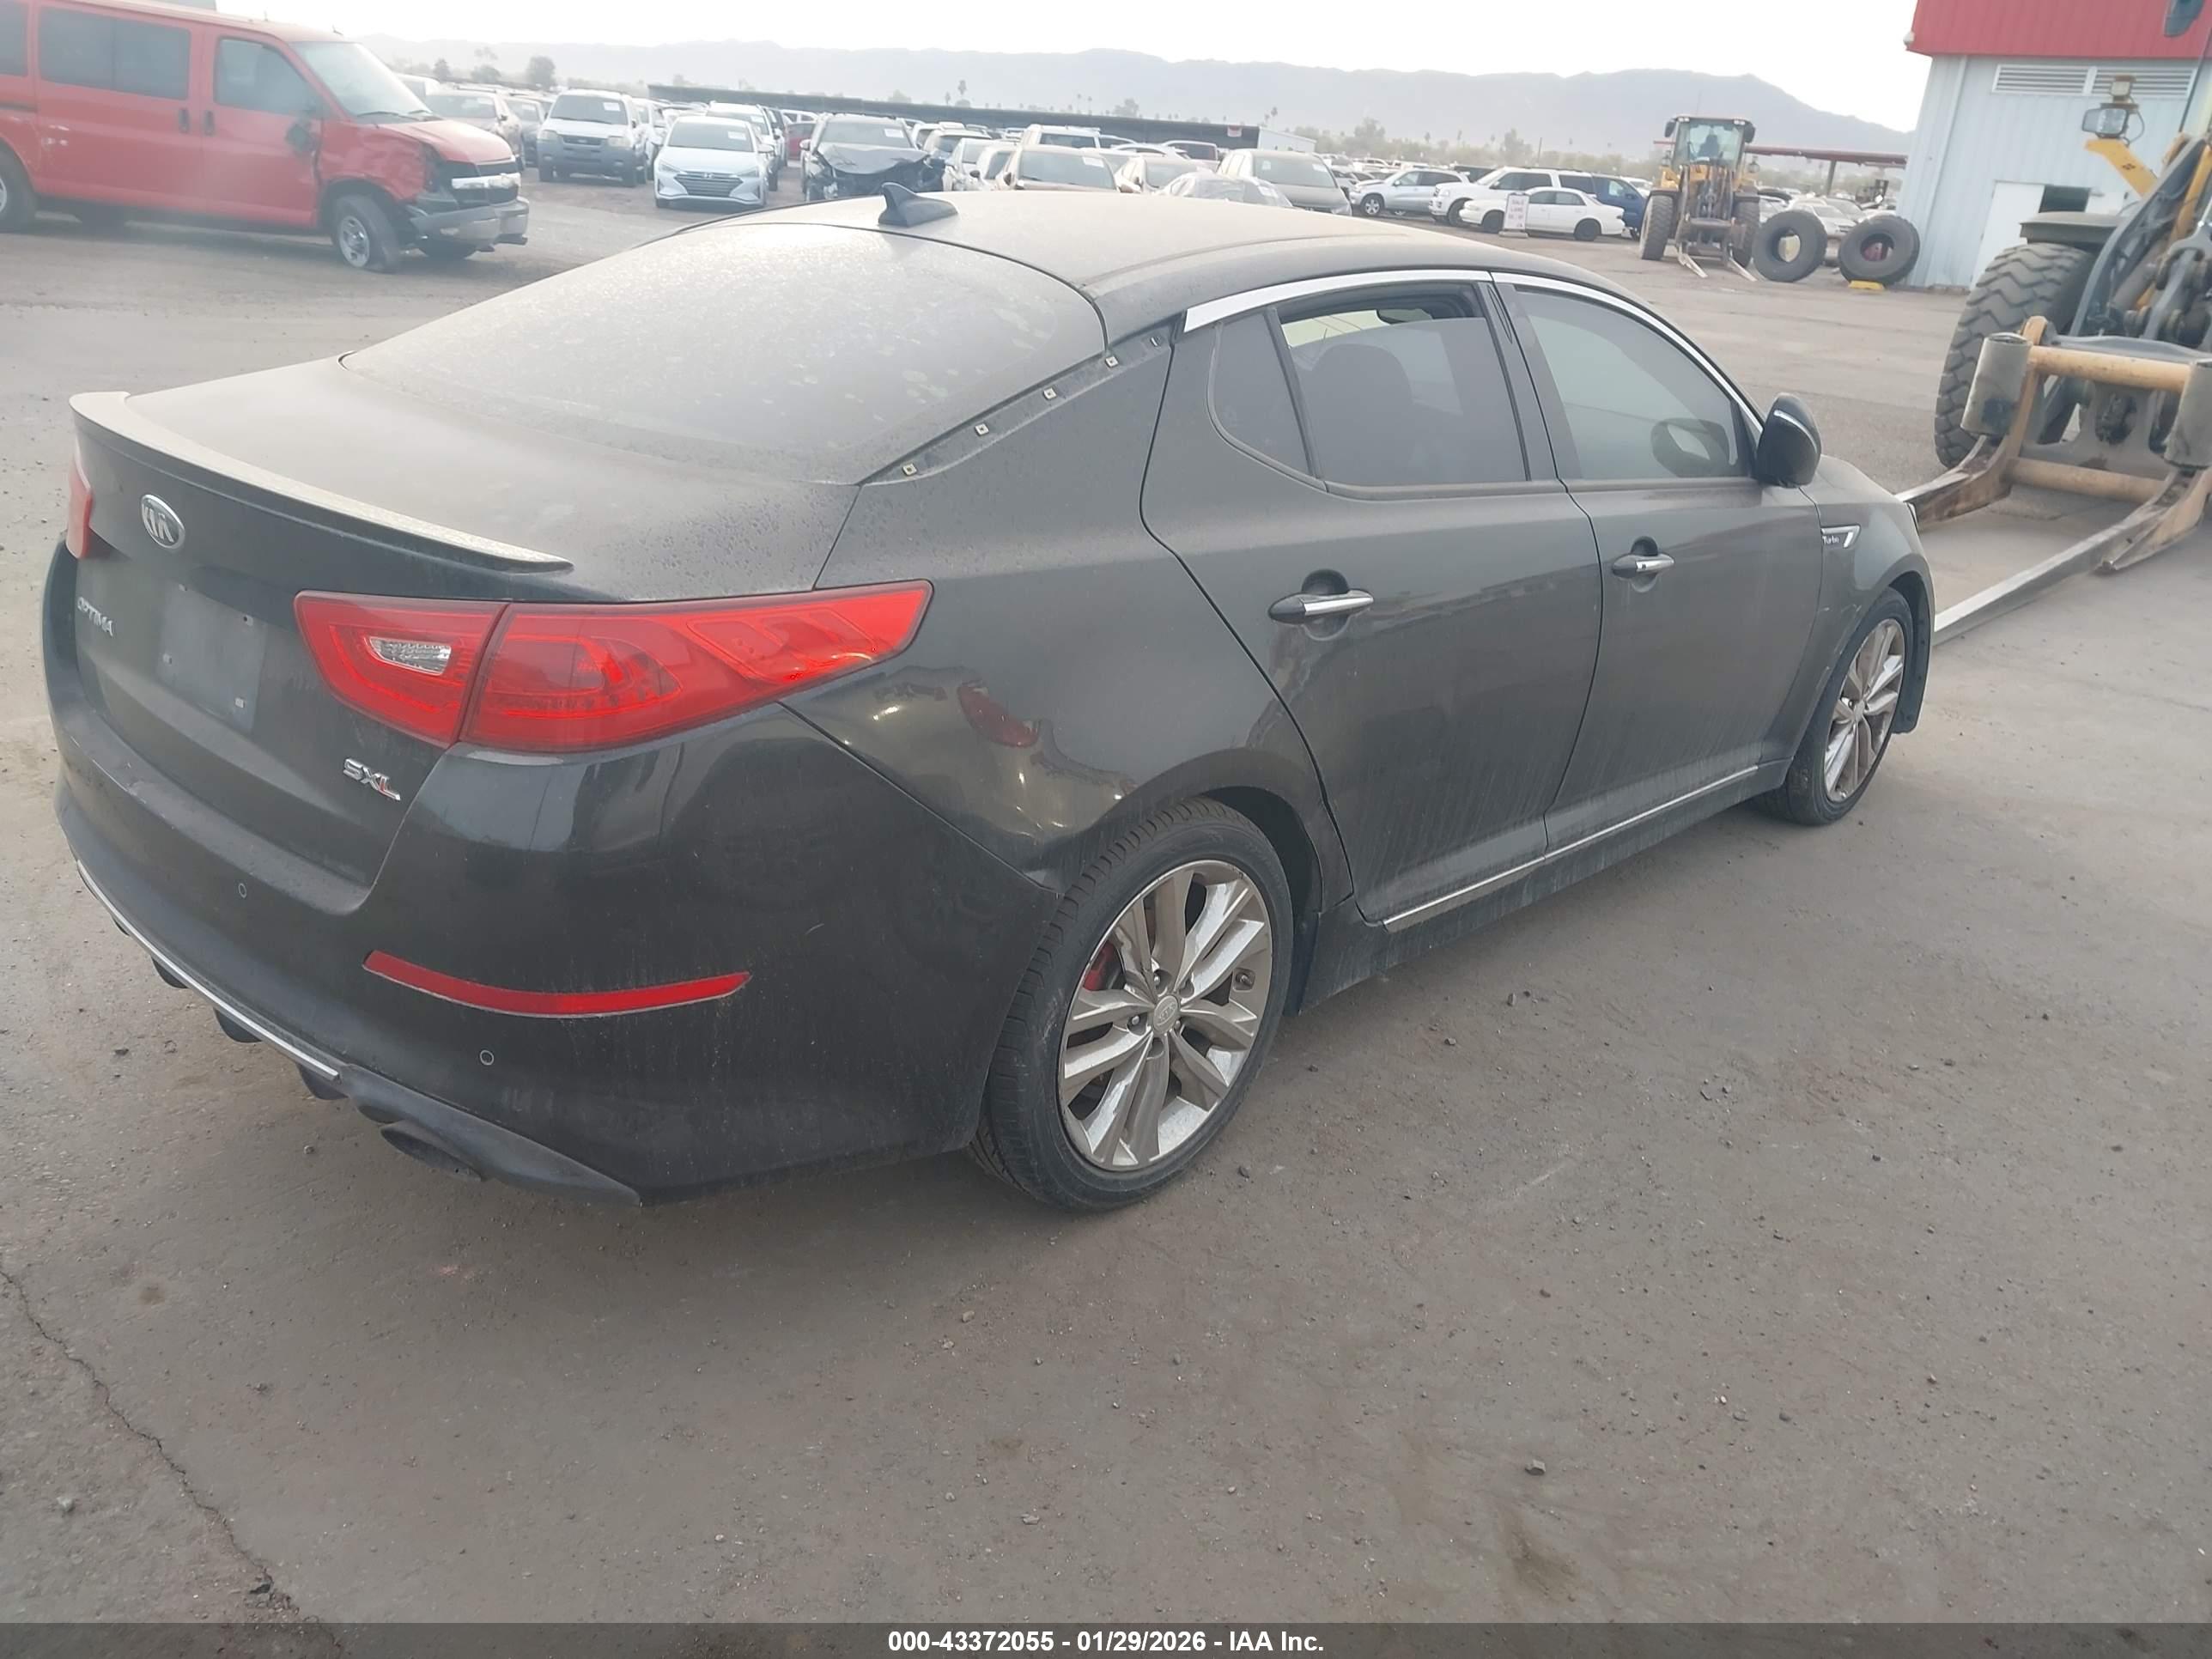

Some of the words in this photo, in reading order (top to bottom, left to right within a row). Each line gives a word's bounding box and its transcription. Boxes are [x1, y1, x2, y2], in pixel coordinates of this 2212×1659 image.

[142, 503, 174, 543] KIA
[77, 597, 113, 636] OPTIMA
[343, 759, 400, 800] SXL
